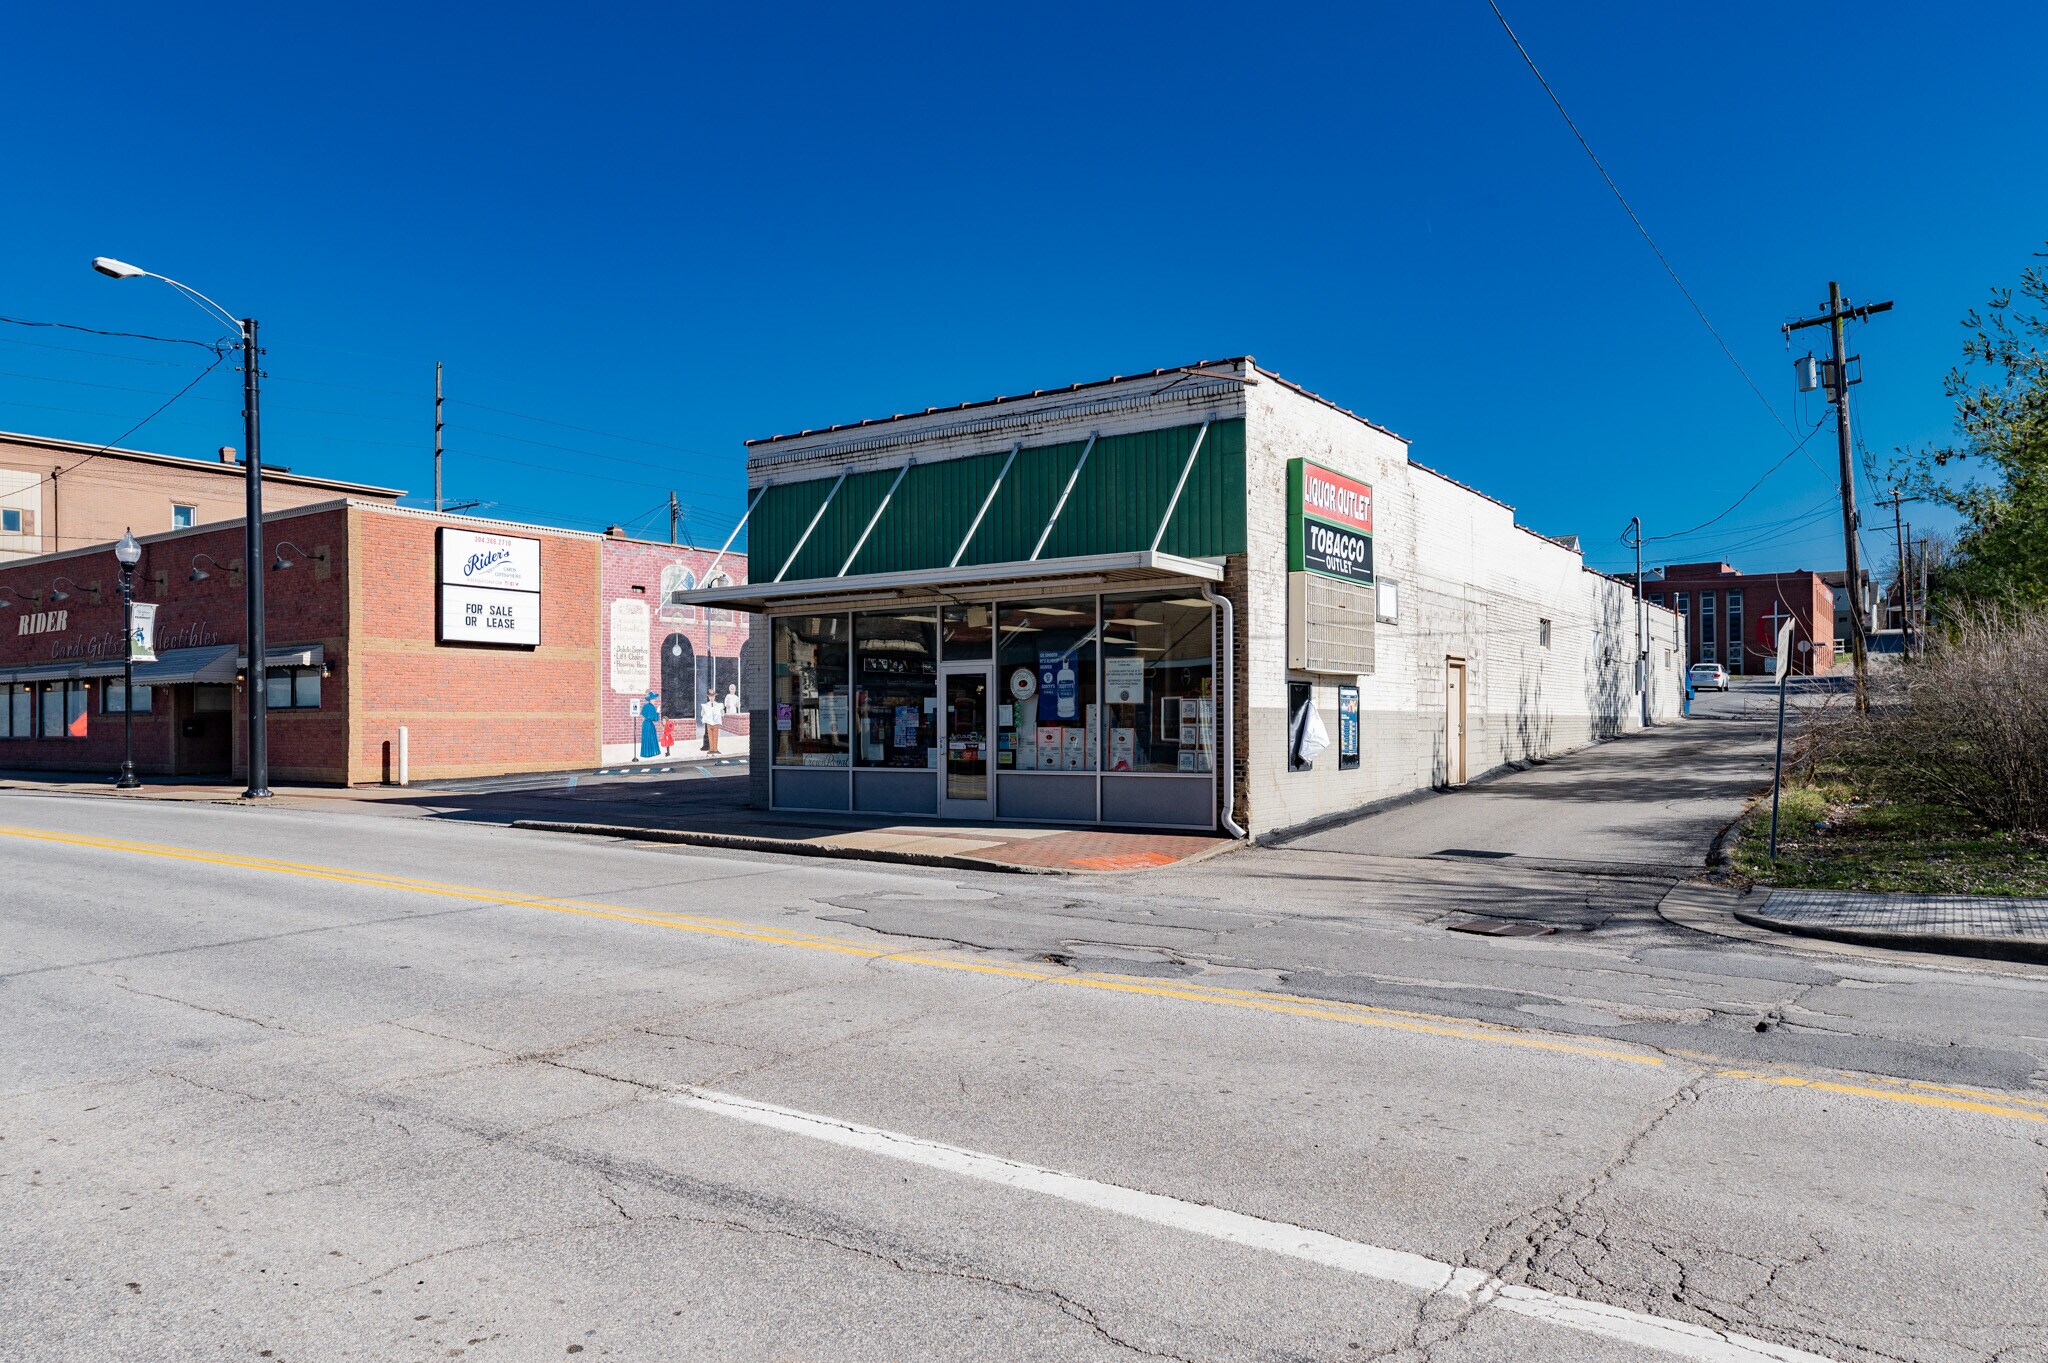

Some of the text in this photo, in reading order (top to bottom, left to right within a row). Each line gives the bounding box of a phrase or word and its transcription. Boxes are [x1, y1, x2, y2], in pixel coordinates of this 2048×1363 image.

[1304, 475, 1371, 522] LIQUOR OUTLET
[1310, 525, 1365, 563] TOBACCO
[463, 548, 511, 577] Rider's
[1326, 555, 1353, 574] OUTLET
[17, 609, 69, 636] RIDER
[465, 616, 515, 629] OR LEASE
[466, 603, 513, 617] FOR SALE
[51, 621, 218, 661] Cards Gifts llectibles
